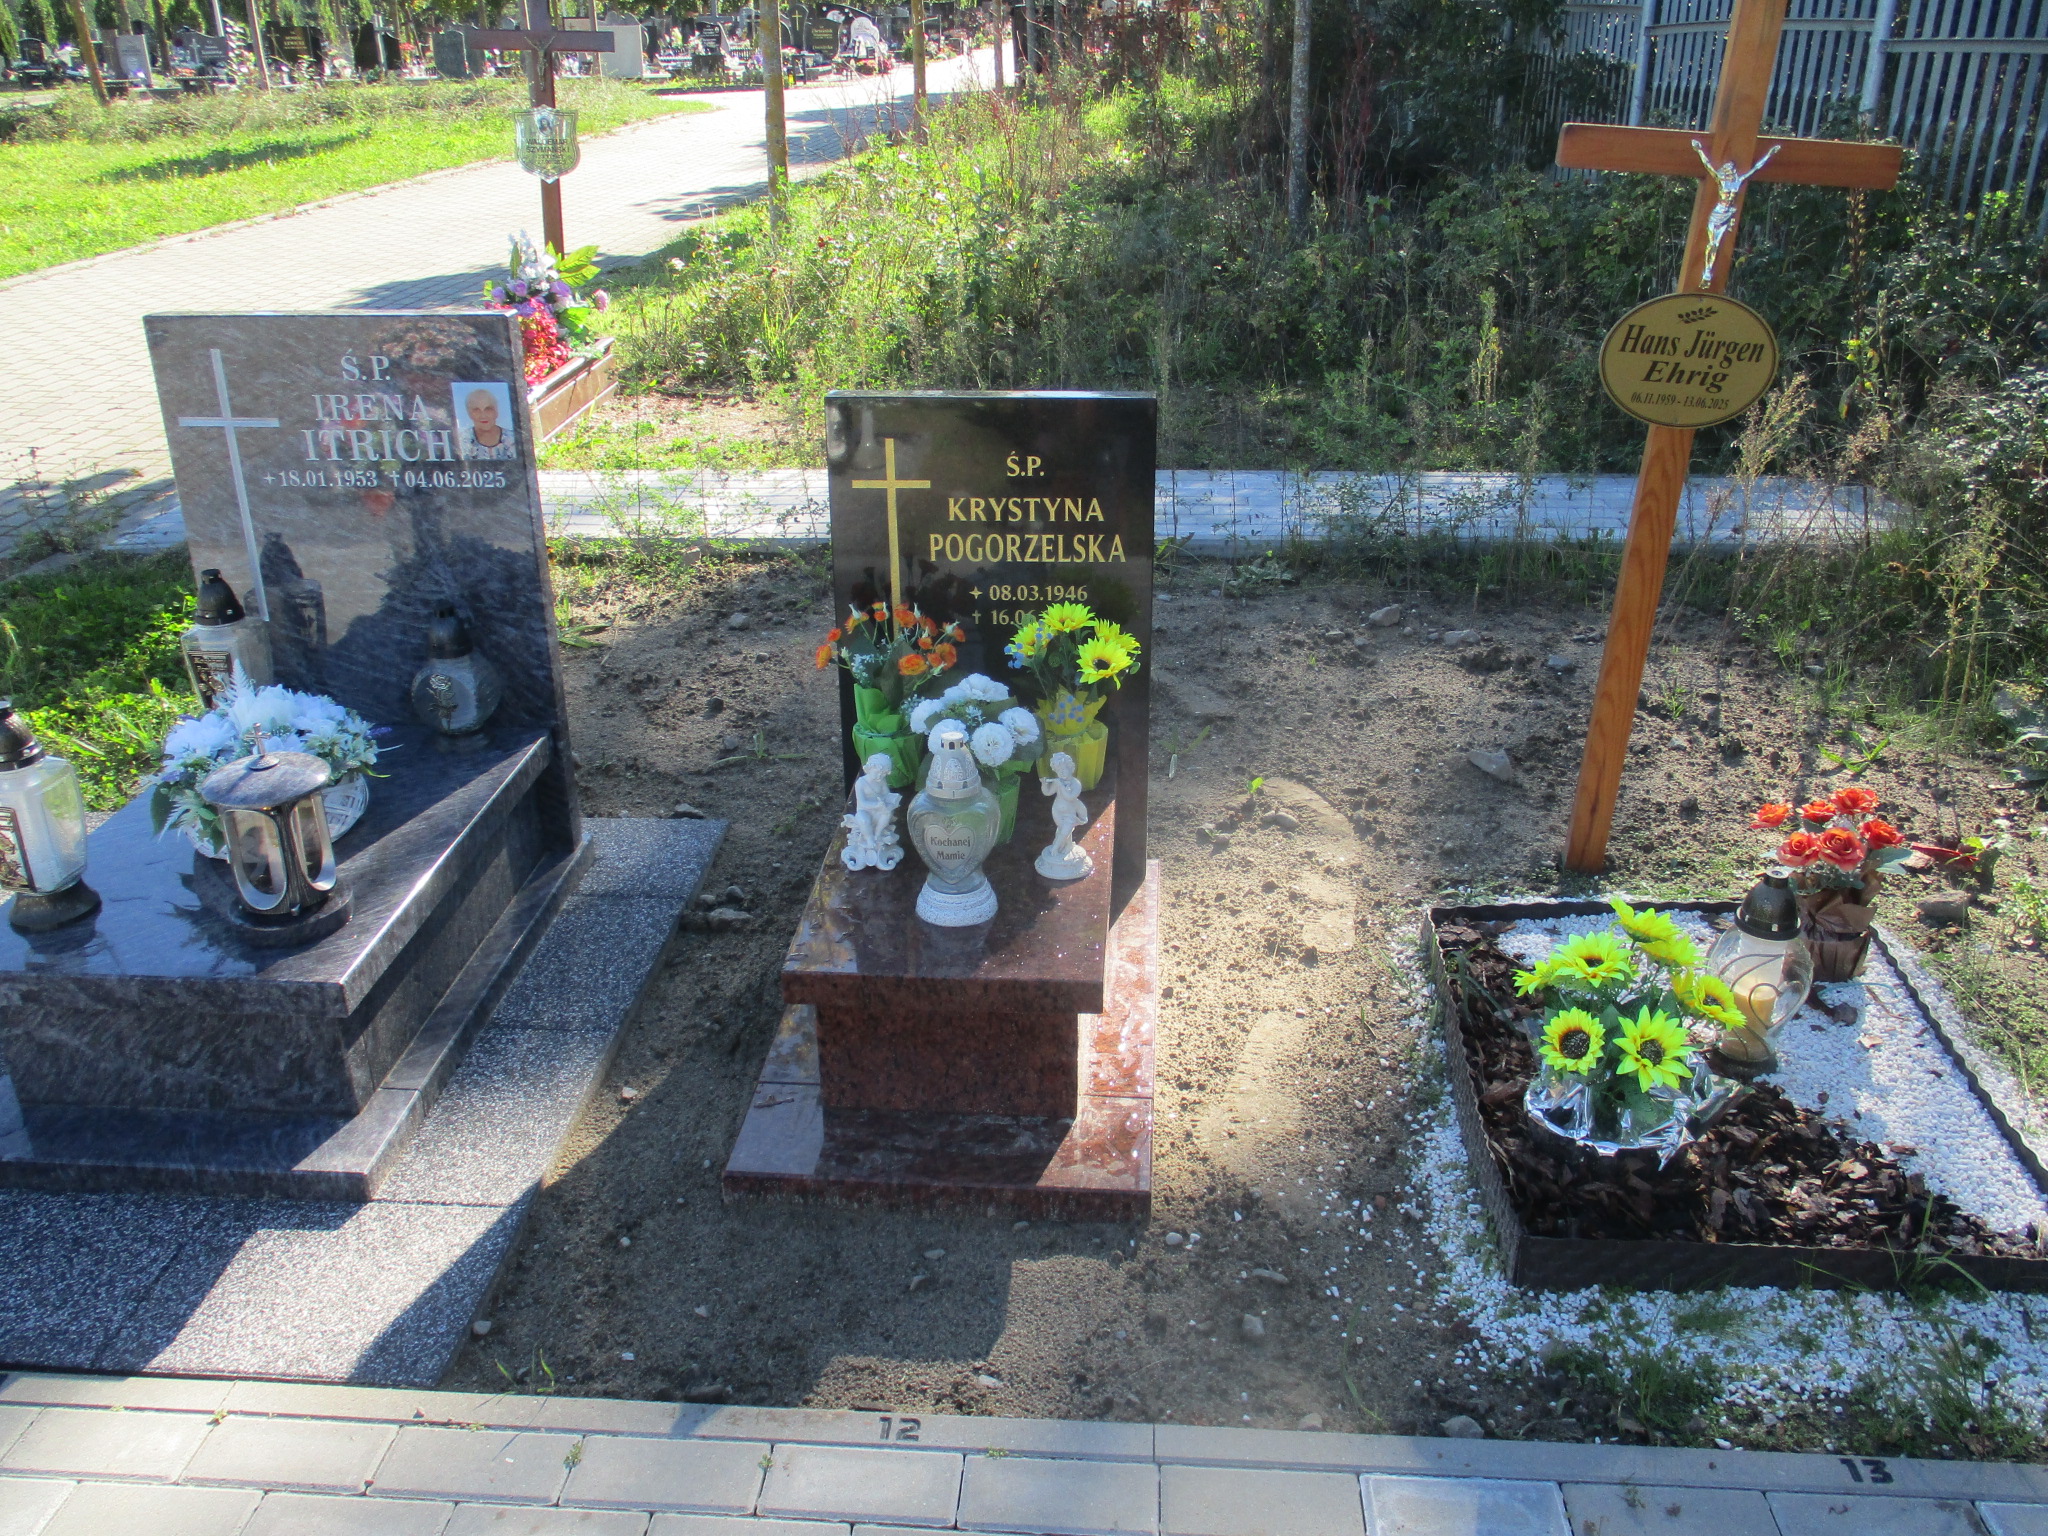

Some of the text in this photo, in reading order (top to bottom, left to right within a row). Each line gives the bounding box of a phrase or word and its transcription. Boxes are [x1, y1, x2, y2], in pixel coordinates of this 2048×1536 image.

[1618, 323, 1765, 370] Hans Jürgen
[340, 348, 391, 381] Ś.P.
[1640, 360, 1730, 394] Ehrig
[311, 394, 433, 421] IRENA
[301, 429, 455, 462] ITRICH
[1006, 450, 1045, 477] Ś.P.
[404, 470, 506, 488] 04.06.2025
[948, 497, 1105, 522] KRYSTYNA
[929, 533, 1127, 563] POGORZELSKA
[989, 585, 1088, 601] 08.03.1946
[930, 836, 971, 848] Kochanej
[936, 851, 966, 860] Mamie
[879, 1416, 922, 1441] 12
[1838, 1458, 1894, 1483] 13
